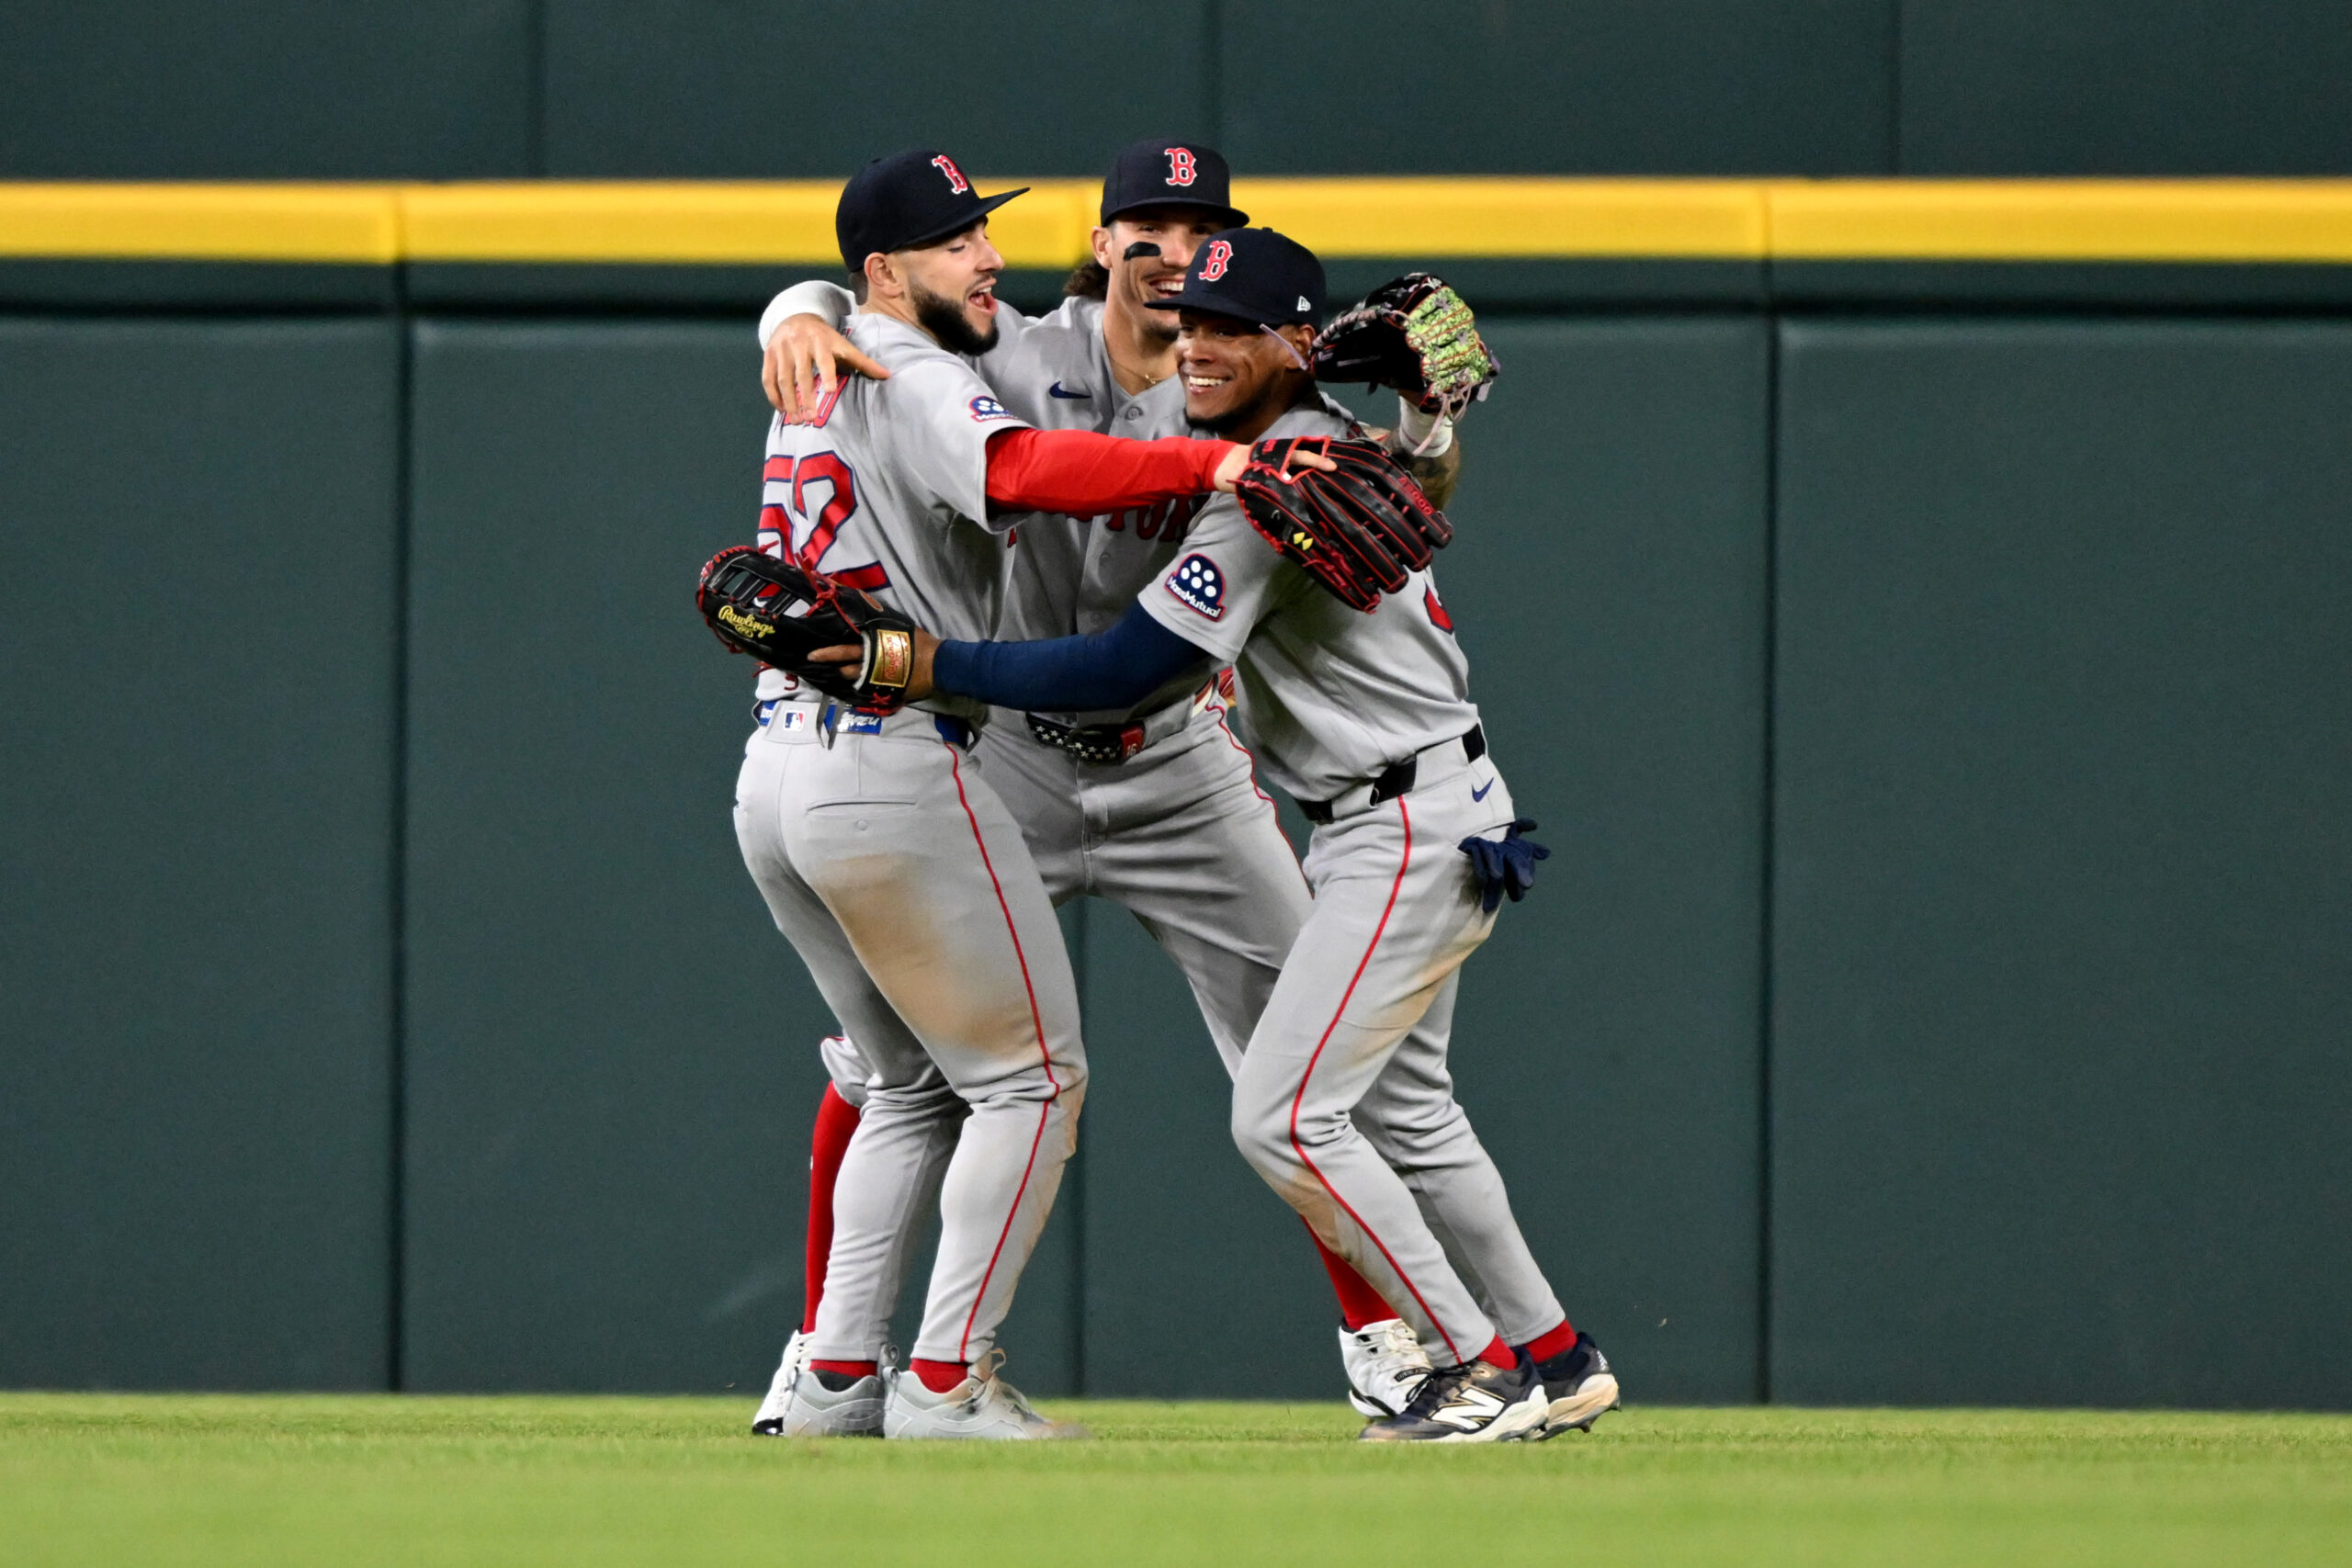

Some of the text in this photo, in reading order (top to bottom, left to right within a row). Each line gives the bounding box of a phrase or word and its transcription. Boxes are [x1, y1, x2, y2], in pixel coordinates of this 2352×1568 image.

[932, 154, 968, 195] B
[1164, 147, 1198, 186] B
[1198, 240, 1234, 282] B
[1166, 575, 1223, 618] MassMutual
[718, 604, 776, 638] Rawlings
